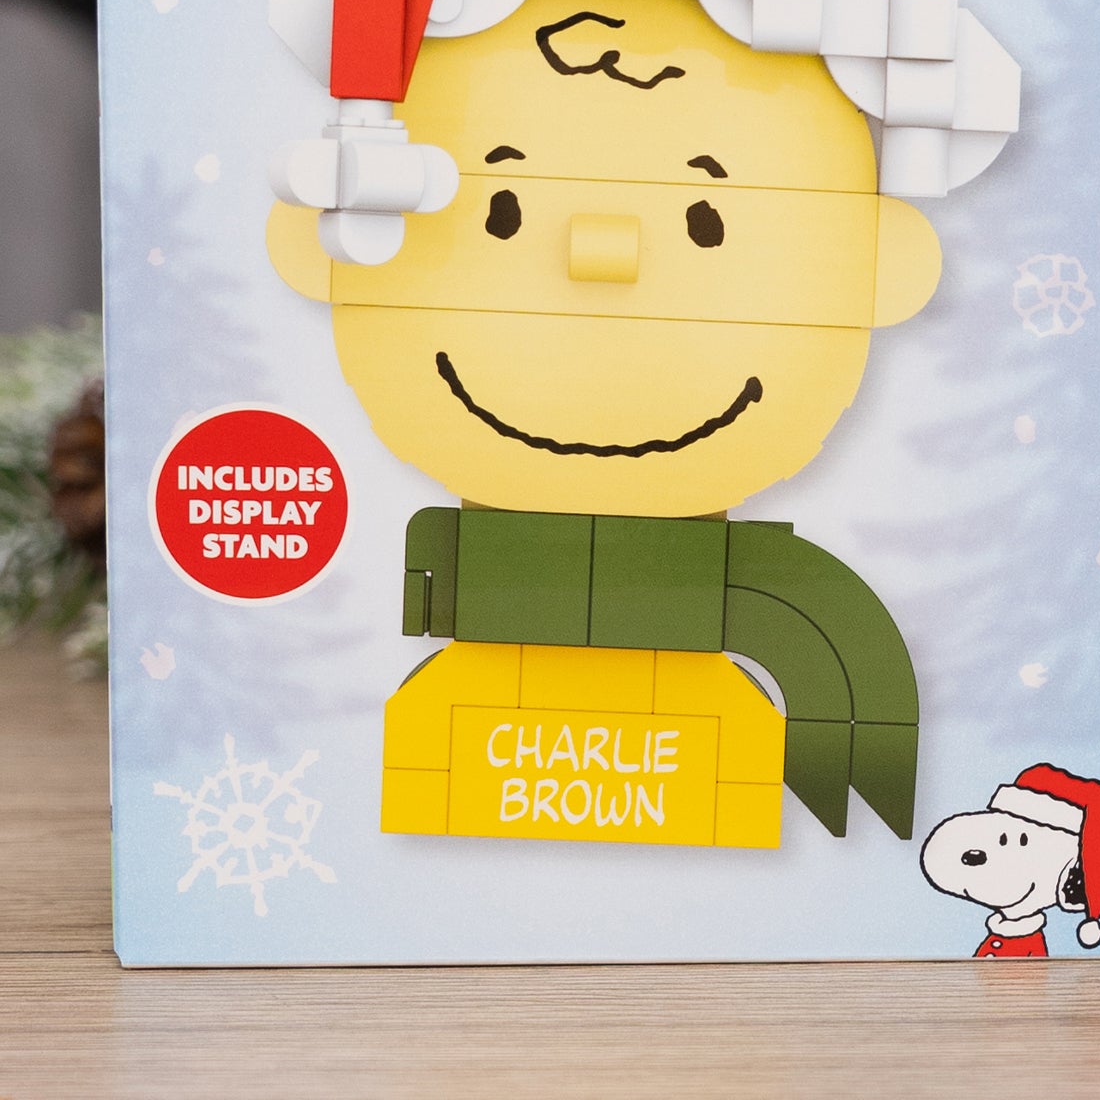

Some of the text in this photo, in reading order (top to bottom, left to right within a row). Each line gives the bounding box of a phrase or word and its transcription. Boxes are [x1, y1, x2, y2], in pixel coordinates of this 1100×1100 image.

[177, 465, 334, 492] INCLUDES
[188, 499, 322, 526] DISPLAY
[202, 533, 309, 560] STAND
[486, 723, 681, 775] CHARLIE
[499, 777, 665, 828] BROWN
